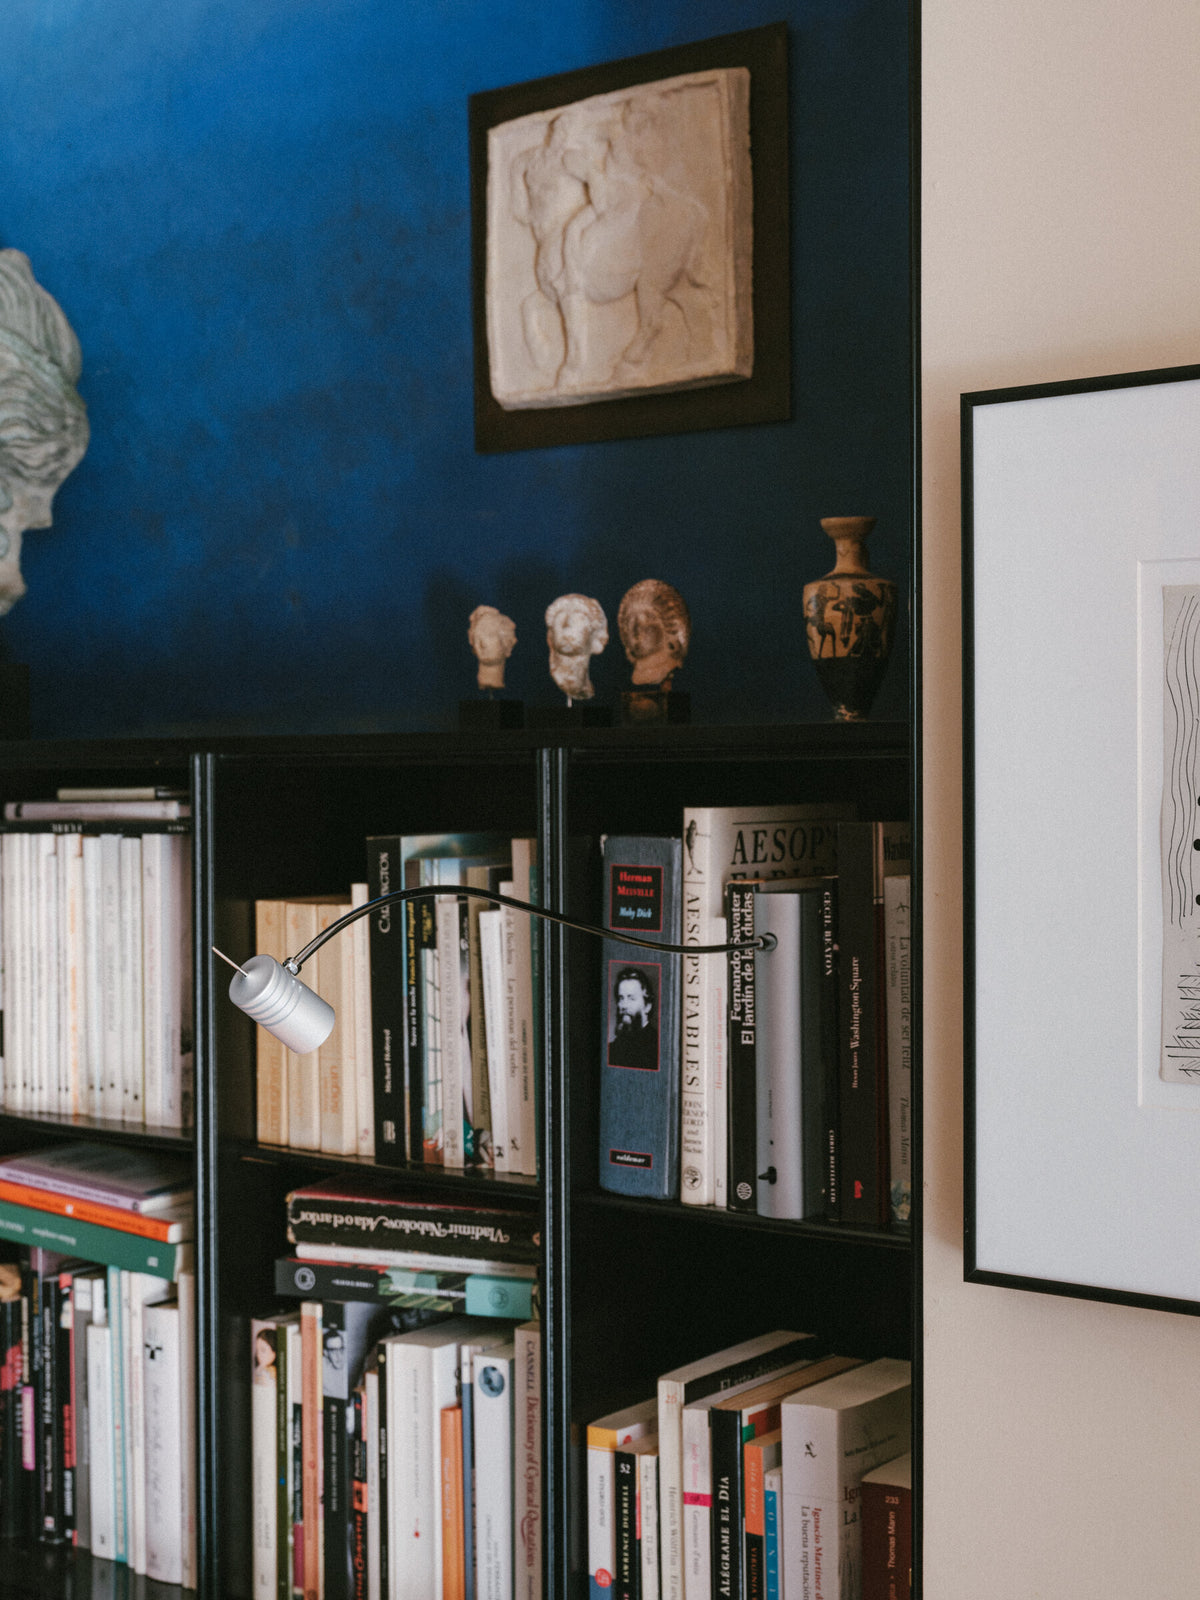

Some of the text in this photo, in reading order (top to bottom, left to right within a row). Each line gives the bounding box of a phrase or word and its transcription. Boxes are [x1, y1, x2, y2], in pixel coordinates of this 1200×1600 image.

[731, 826, 839, 865] AESOP'
[379, 852, 391, 934] CARNGTON
[619, 871, 653, 883] Herman
[618, 906, 654, 920] Moby Dick
[740, 892, 755, 937] dudas
[823, 891, 833, 976] CECIL BEATON
[899, 936, 911, 951] La
[407, 959, 416, 986] Francis
[730, 892, 742, 1021] Fernando Savater
[741, 963, 755, 982] de
[848, 956, 862, 991] Square
[685, 892, 701, 1088] AESOP'S FABLES
[899, 953, 911, 1004] voluntad
[741, 985, 756, 1027] jardín
[848, 991, 862, 1049] Washington
[900, 1007, 911, 1022] de
[741, 1030, 755, 1045] El
[899, 1096, 910, 1165] Thomas Mann
[294, 1211, 332, 1226] ardor
[353, 1216, 388, 1232] Ada
[383, 1218, 449, 1238] Nabokov
[449, 1224, 510, 1243] Vladimir
[526, 1340, 536, 1392] CASSELL
[523, 1395, 541, 1451] Dictionary
[526, 1452, 541, 1466] of
[619, 1462, 631, 1474] 52
[523, 1466, 540, 1509] Cynical
[521, 1509, 541, 1568] Quotations
[622, 1485, 630, 1584] LAWRENCE DURRELL
[717, 1476, 731, 1597] ALÉGRAME EL DÍA
[811, 1507, 824, 1545] Ignacio
[887, 1511, 896, 1535] Mann
[750, 1546, 759, 1593] VIRGINIA
[800, 1505, 812, 1600] La buena reputación
[887, 1536, 896, 1569] Thomas
